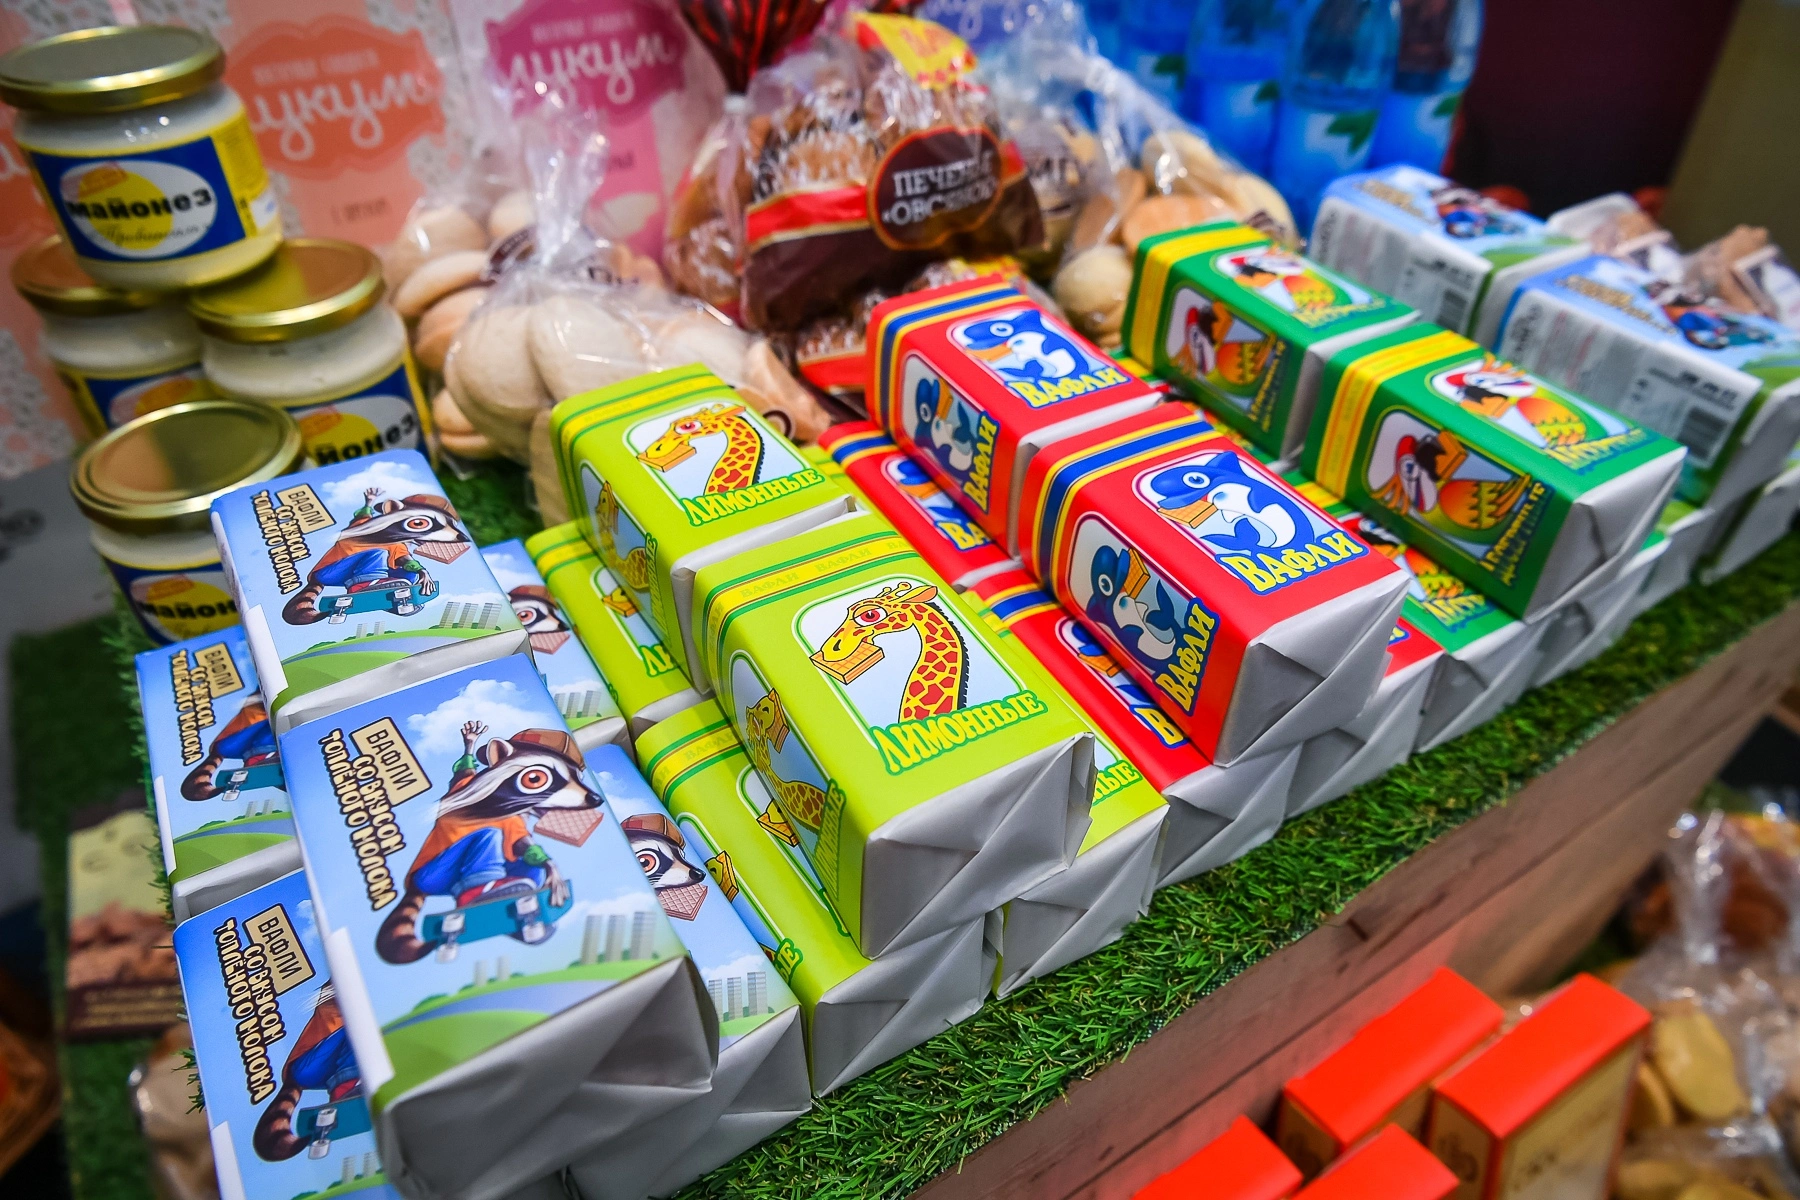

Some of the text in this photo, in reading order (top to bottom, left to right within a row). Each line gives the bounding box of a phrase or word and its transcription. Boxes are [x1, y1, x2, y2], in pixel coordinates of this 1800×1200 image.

[66, 188, 212, 221] майонез
[1010, 367, 1130, 408] ВАФЛИ
[962, 411, 999, 514] ВАФЛИ
[287, 490, 326, 527] ВАФЛИ
[682, 468, 825, 527] ЛИМОННЫЕ
[268, 544, 303, 595] МОЛОКА
[740, 572, 799, 598] ВАФЛИ
[814, 547, 872, 573] ВАФЛИ
[1219, 530, 1369, 595] ВАФЛИ
[1154, 599, 1219, 716] ВАФЛИ
[366, 728, 418, 791] ВАФЛИ
[869, 690, 1048, 776] ЛИМОННЫЕ
[318, 728, 398, 911] ТОПЛЁНОГО МОЛОКА
[350, 754, 406, 857] СО ВКУСОМ
[257, 916, 303, 980] ВАФЛИ
[213, 917, 277, 1105] ТОПЛЁНОГО МОЛОКА
[242, 943, 286, 1046] СО ВКУСОМ
